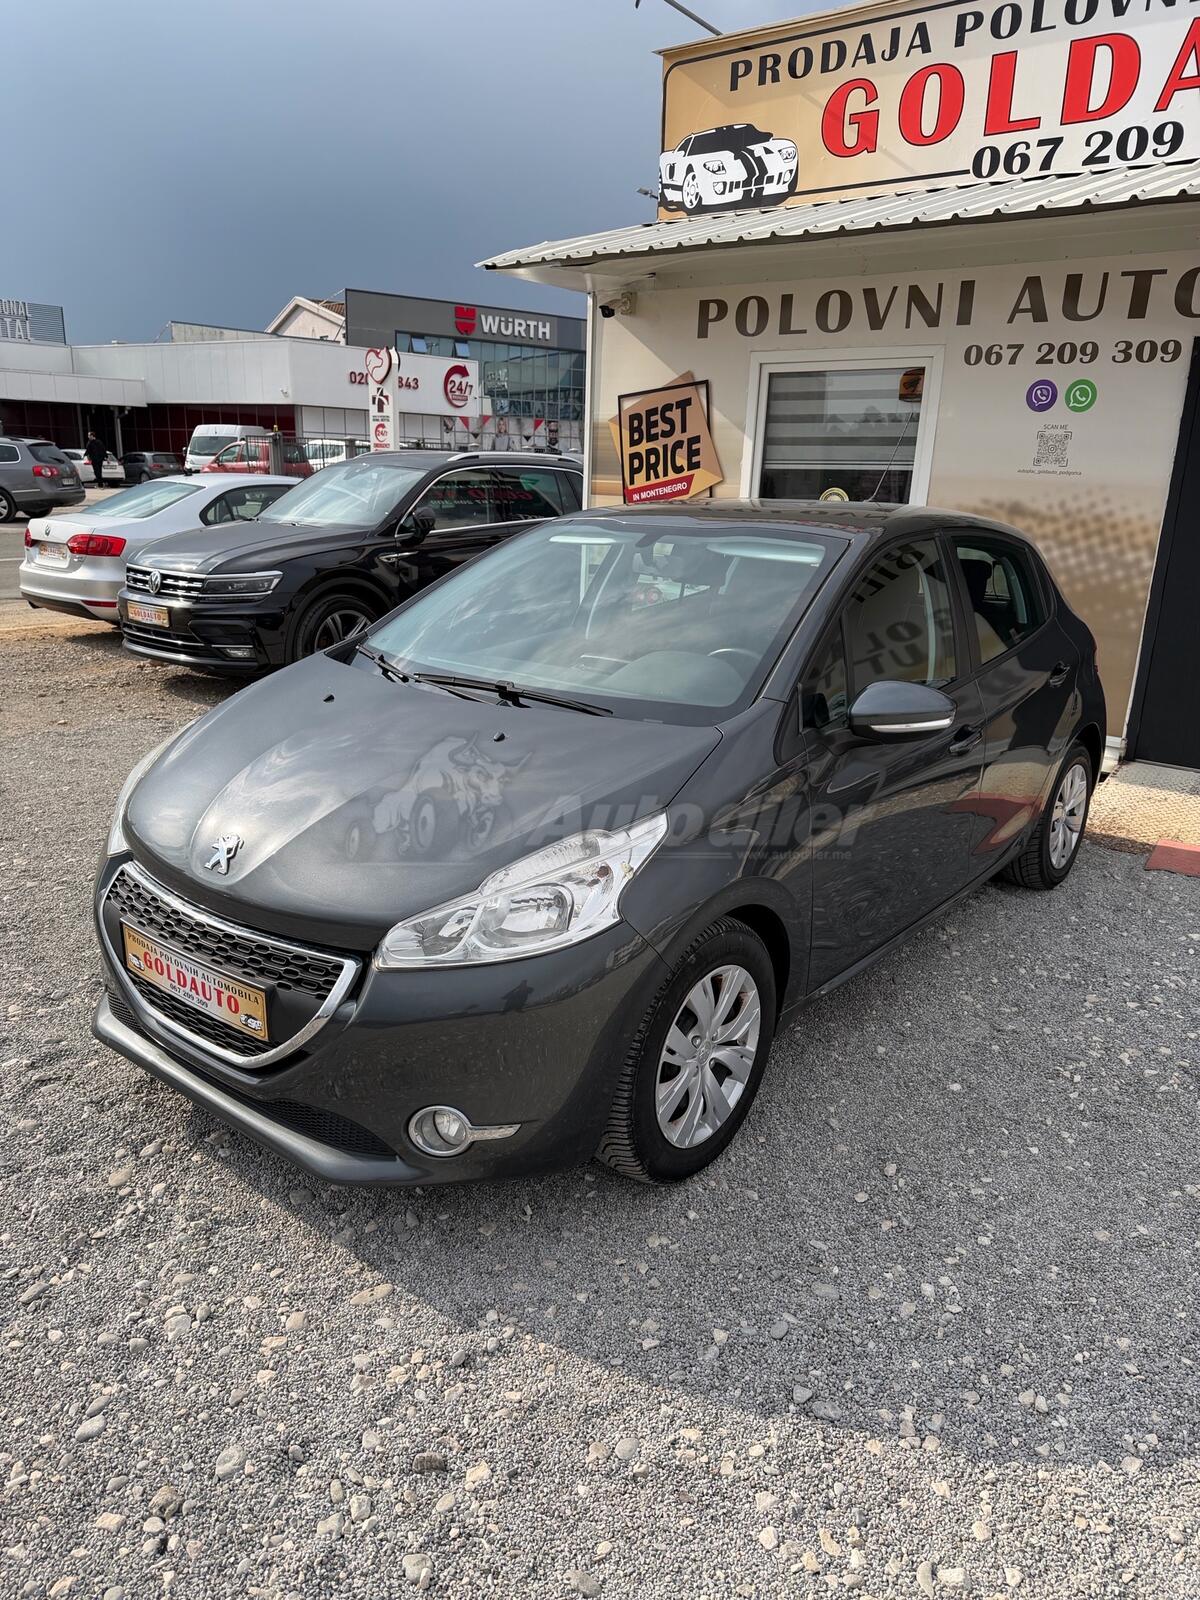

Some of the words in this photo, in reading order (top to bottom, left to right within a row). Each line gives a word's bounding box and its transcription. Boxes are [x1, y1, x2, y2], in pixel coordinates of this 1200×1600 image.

[730, 21, 932, 92] PRODAJA
[972, 136, 1065, 179] 067
[1081, 120, 1185, 167] 209
[480, 314, 551, 340] WÜRTH
[697, 279, 976, 339] POLOVNI
[963, 343, 1025, 366] 067
[1035, 341, 1099, 365] 209
[1111, 338, 1182, 363] 309
[449, 379, 473, 396] 24/7
[628, 396, 692, 448] BEST
[628, 434, 701, 486] PRICE
[632, 493, 640, 502] IN
[640, 481, 688, 500] MONTENEGRO
[127, 932, 159, 955] PRODAJA
[159, 951, 200, 977] POLOVNIH
[200, 972, 260, 1006] AUTOMOBILA
[143, 951, 240, 1014] GOLDAUTO
[169, 983, 182, 994] 067
[183, 989, 195, 1002] 209
[196, 997, 209, 1009] 309
